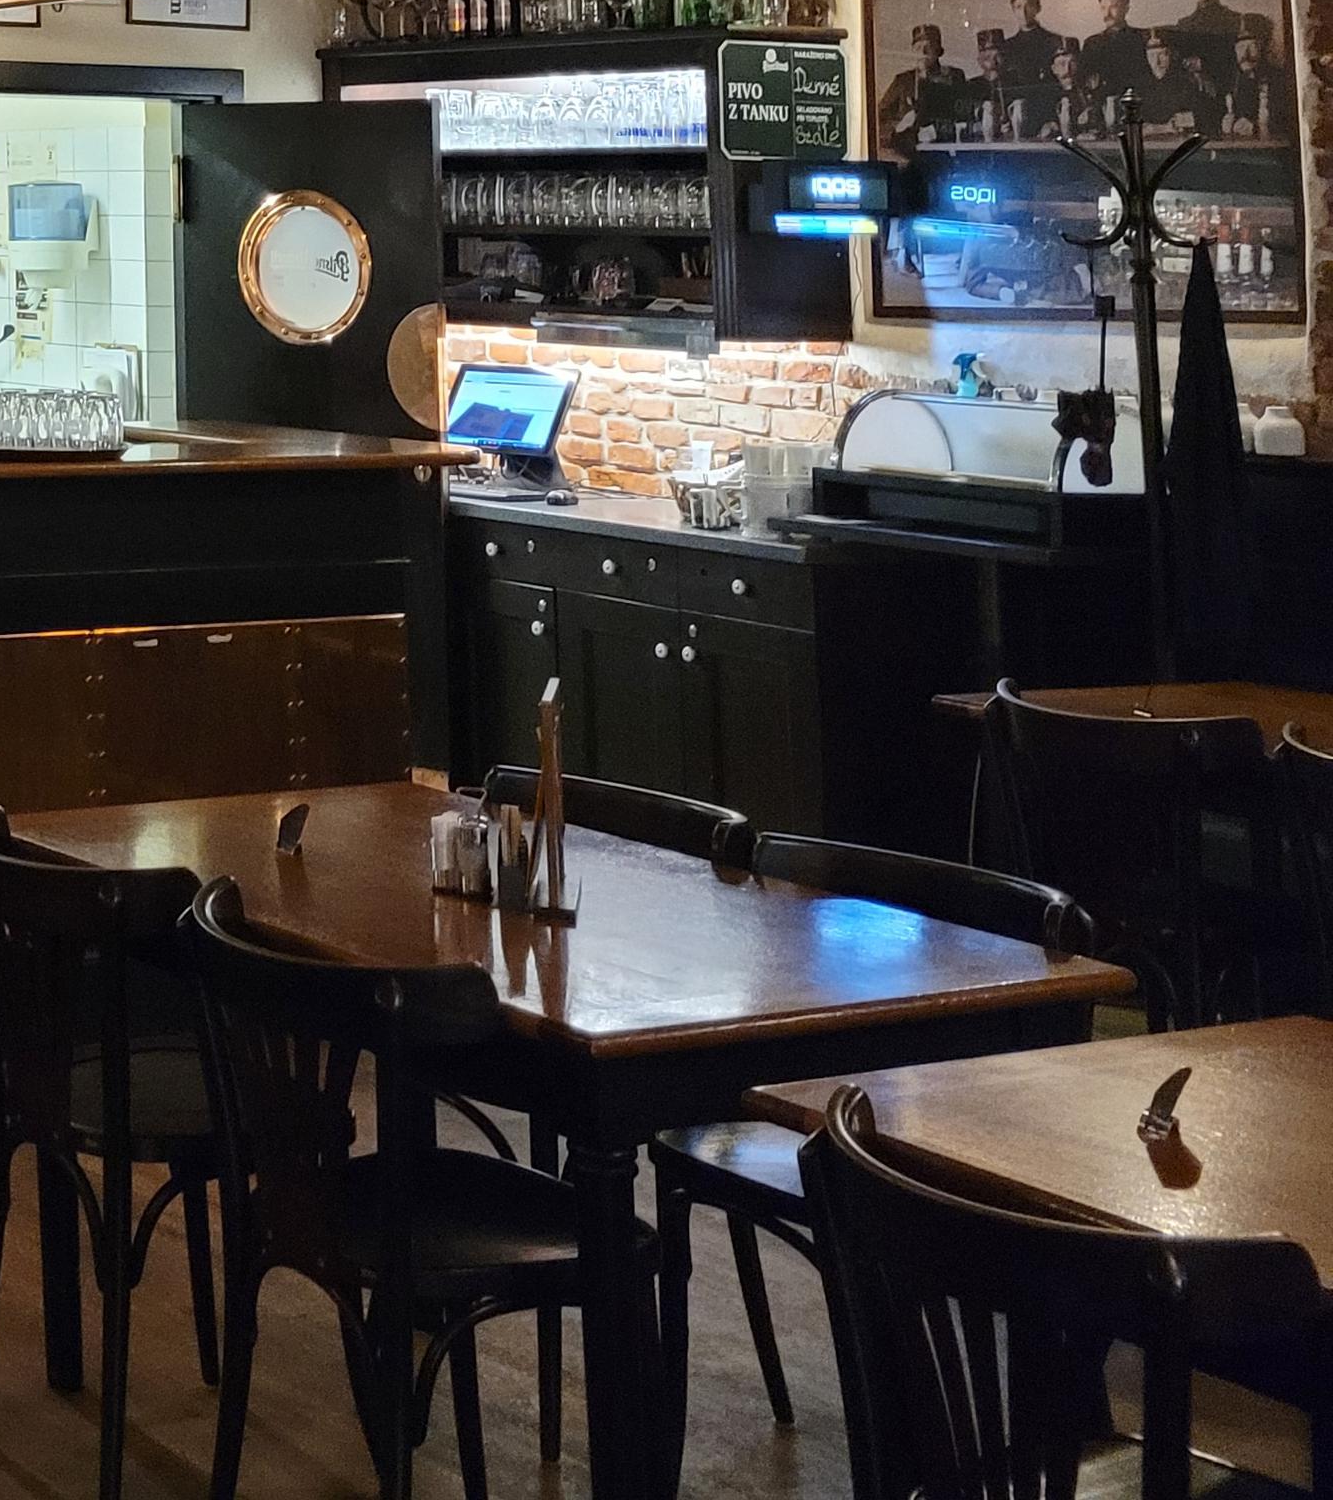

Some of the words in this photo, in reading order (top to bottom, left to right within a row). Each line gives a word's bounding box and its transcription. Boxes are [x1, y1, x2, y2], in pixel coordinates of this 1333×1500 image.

[728, 82, 763, 100] PIVO
[728, 103, 738, 120] Z
[740, 104, 789, 122] TANKU
[811, 177, 861, 198] IQOS
